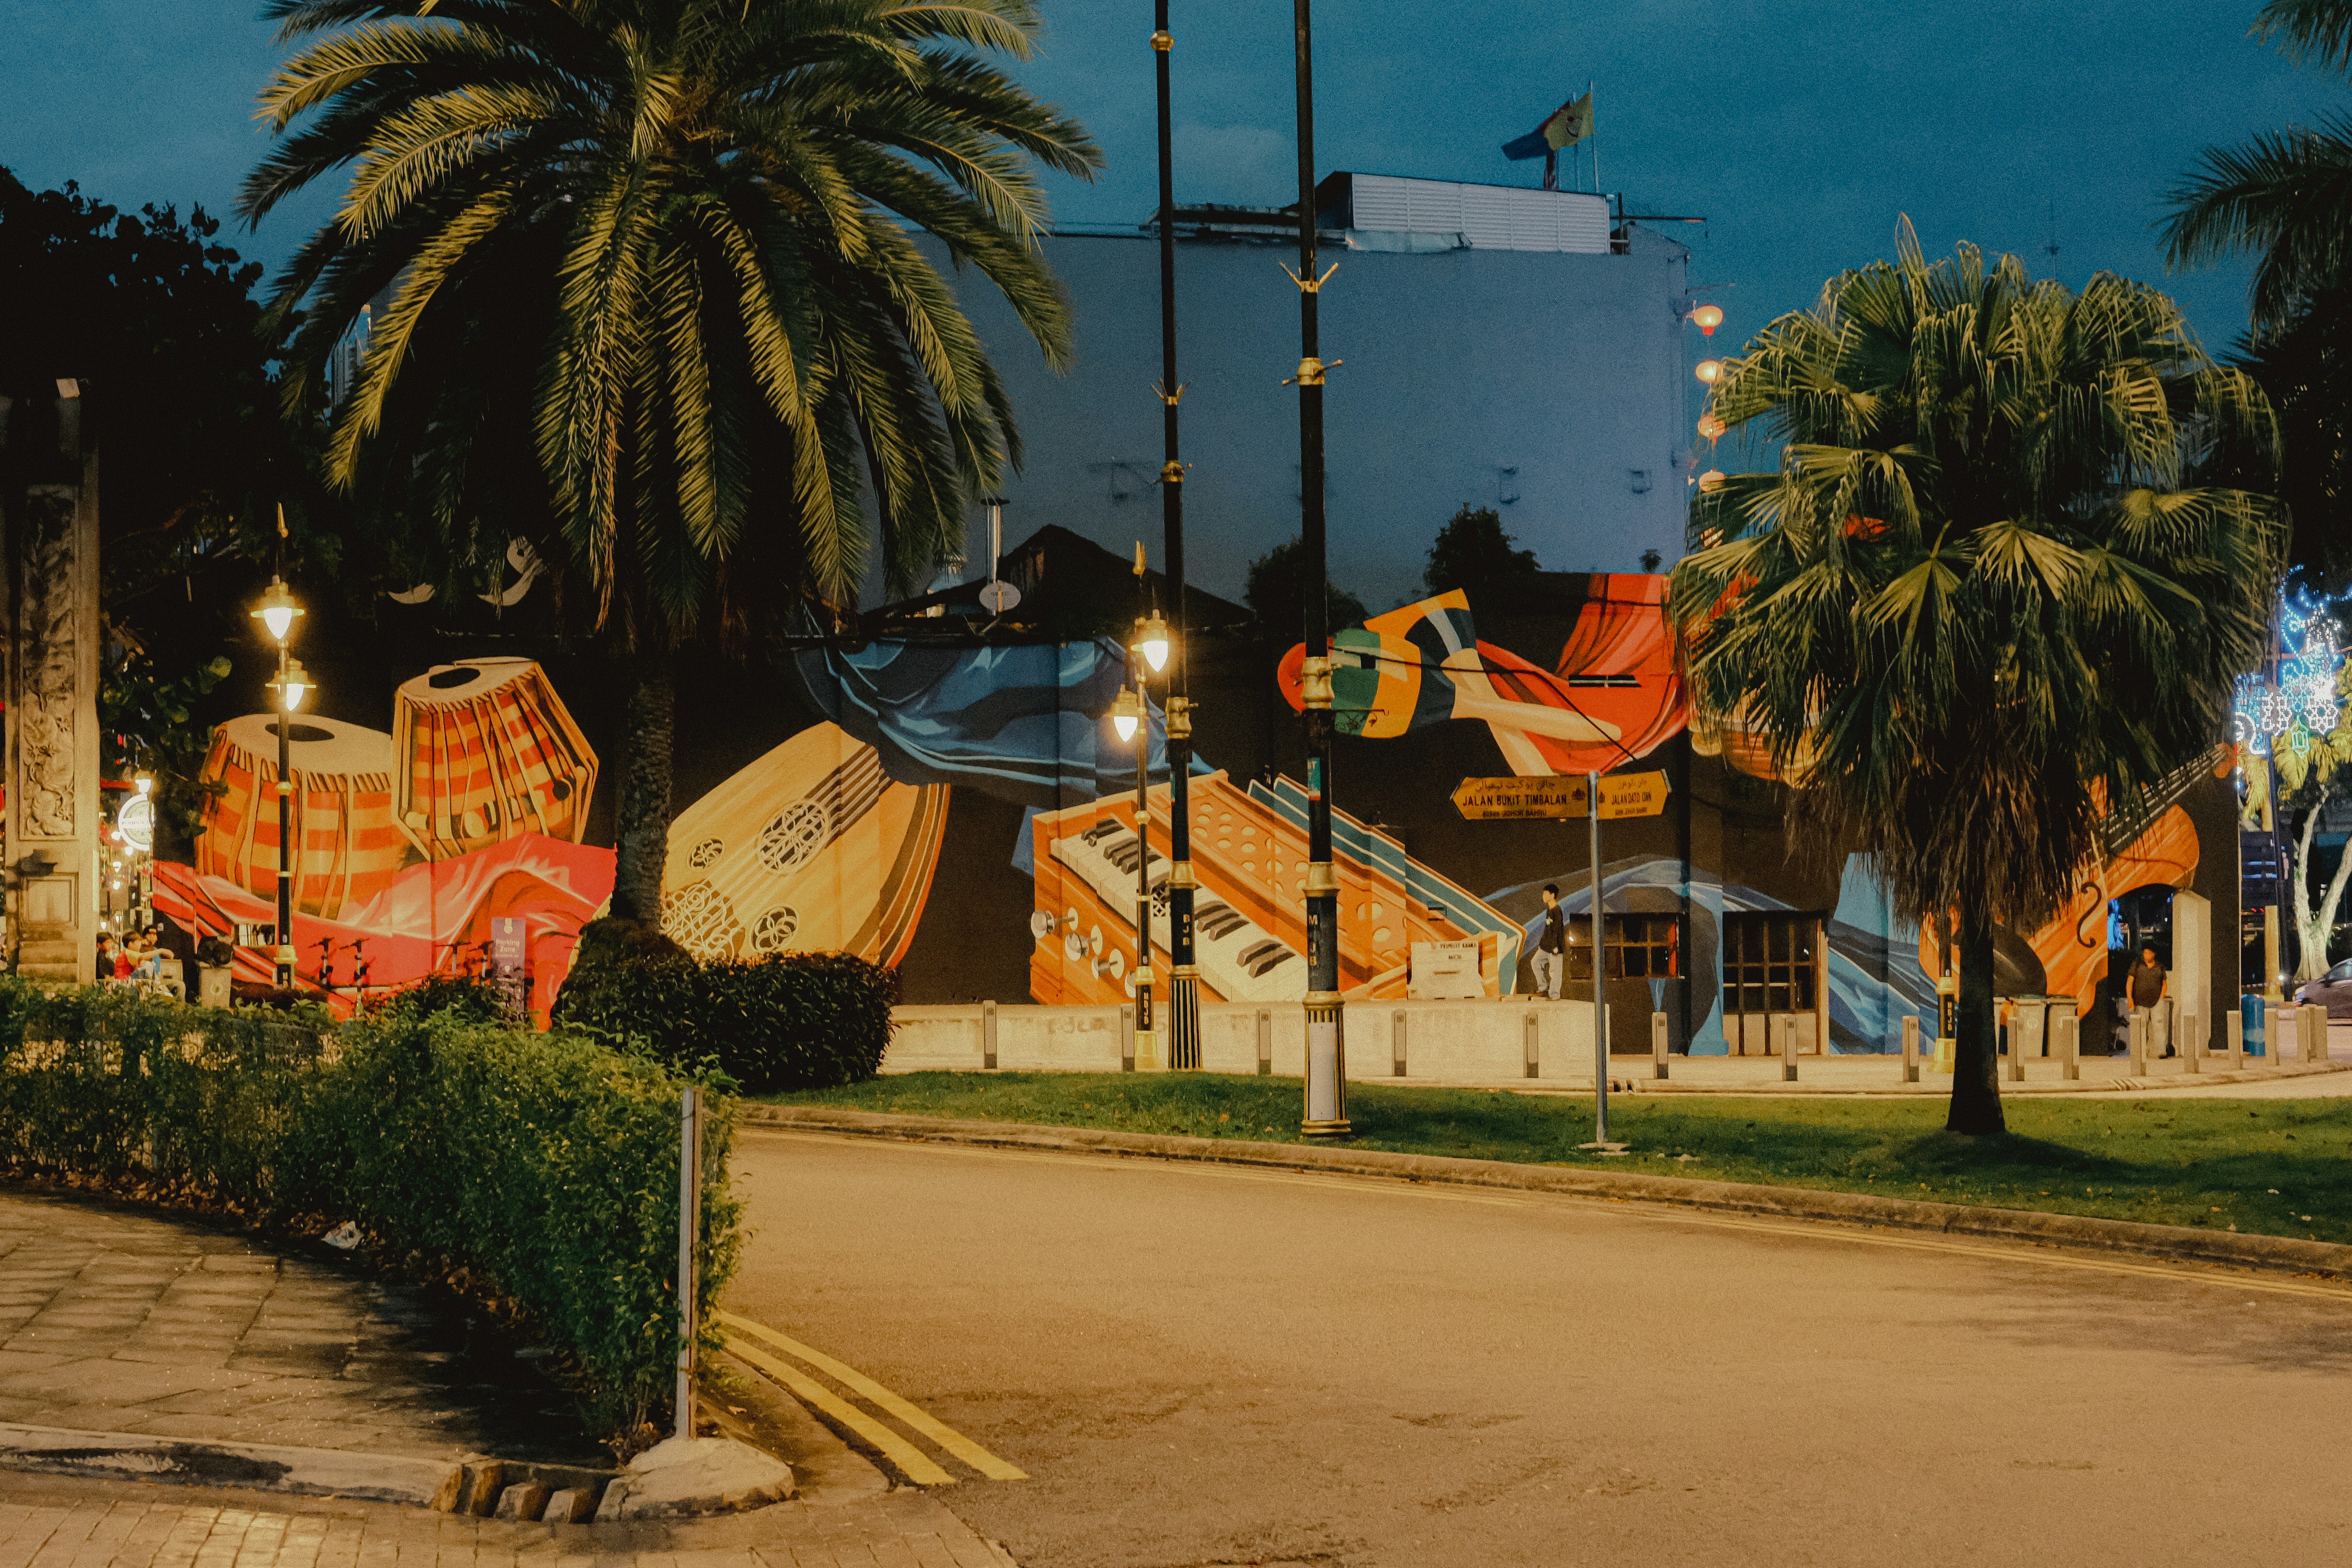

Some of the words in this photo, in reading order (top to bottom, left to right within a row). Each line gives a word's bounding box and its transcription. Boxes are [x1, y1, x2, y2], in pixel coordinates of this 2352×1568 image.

[1463, 795, 1493, 806] JALAN
[1496, 794, 1520, 806] BUKIT
[1525, 793, 1567, 805] TIMBALAN
[1611, 793, 1627, 805] JALAN
[495, 939, 520, 947] Parking
